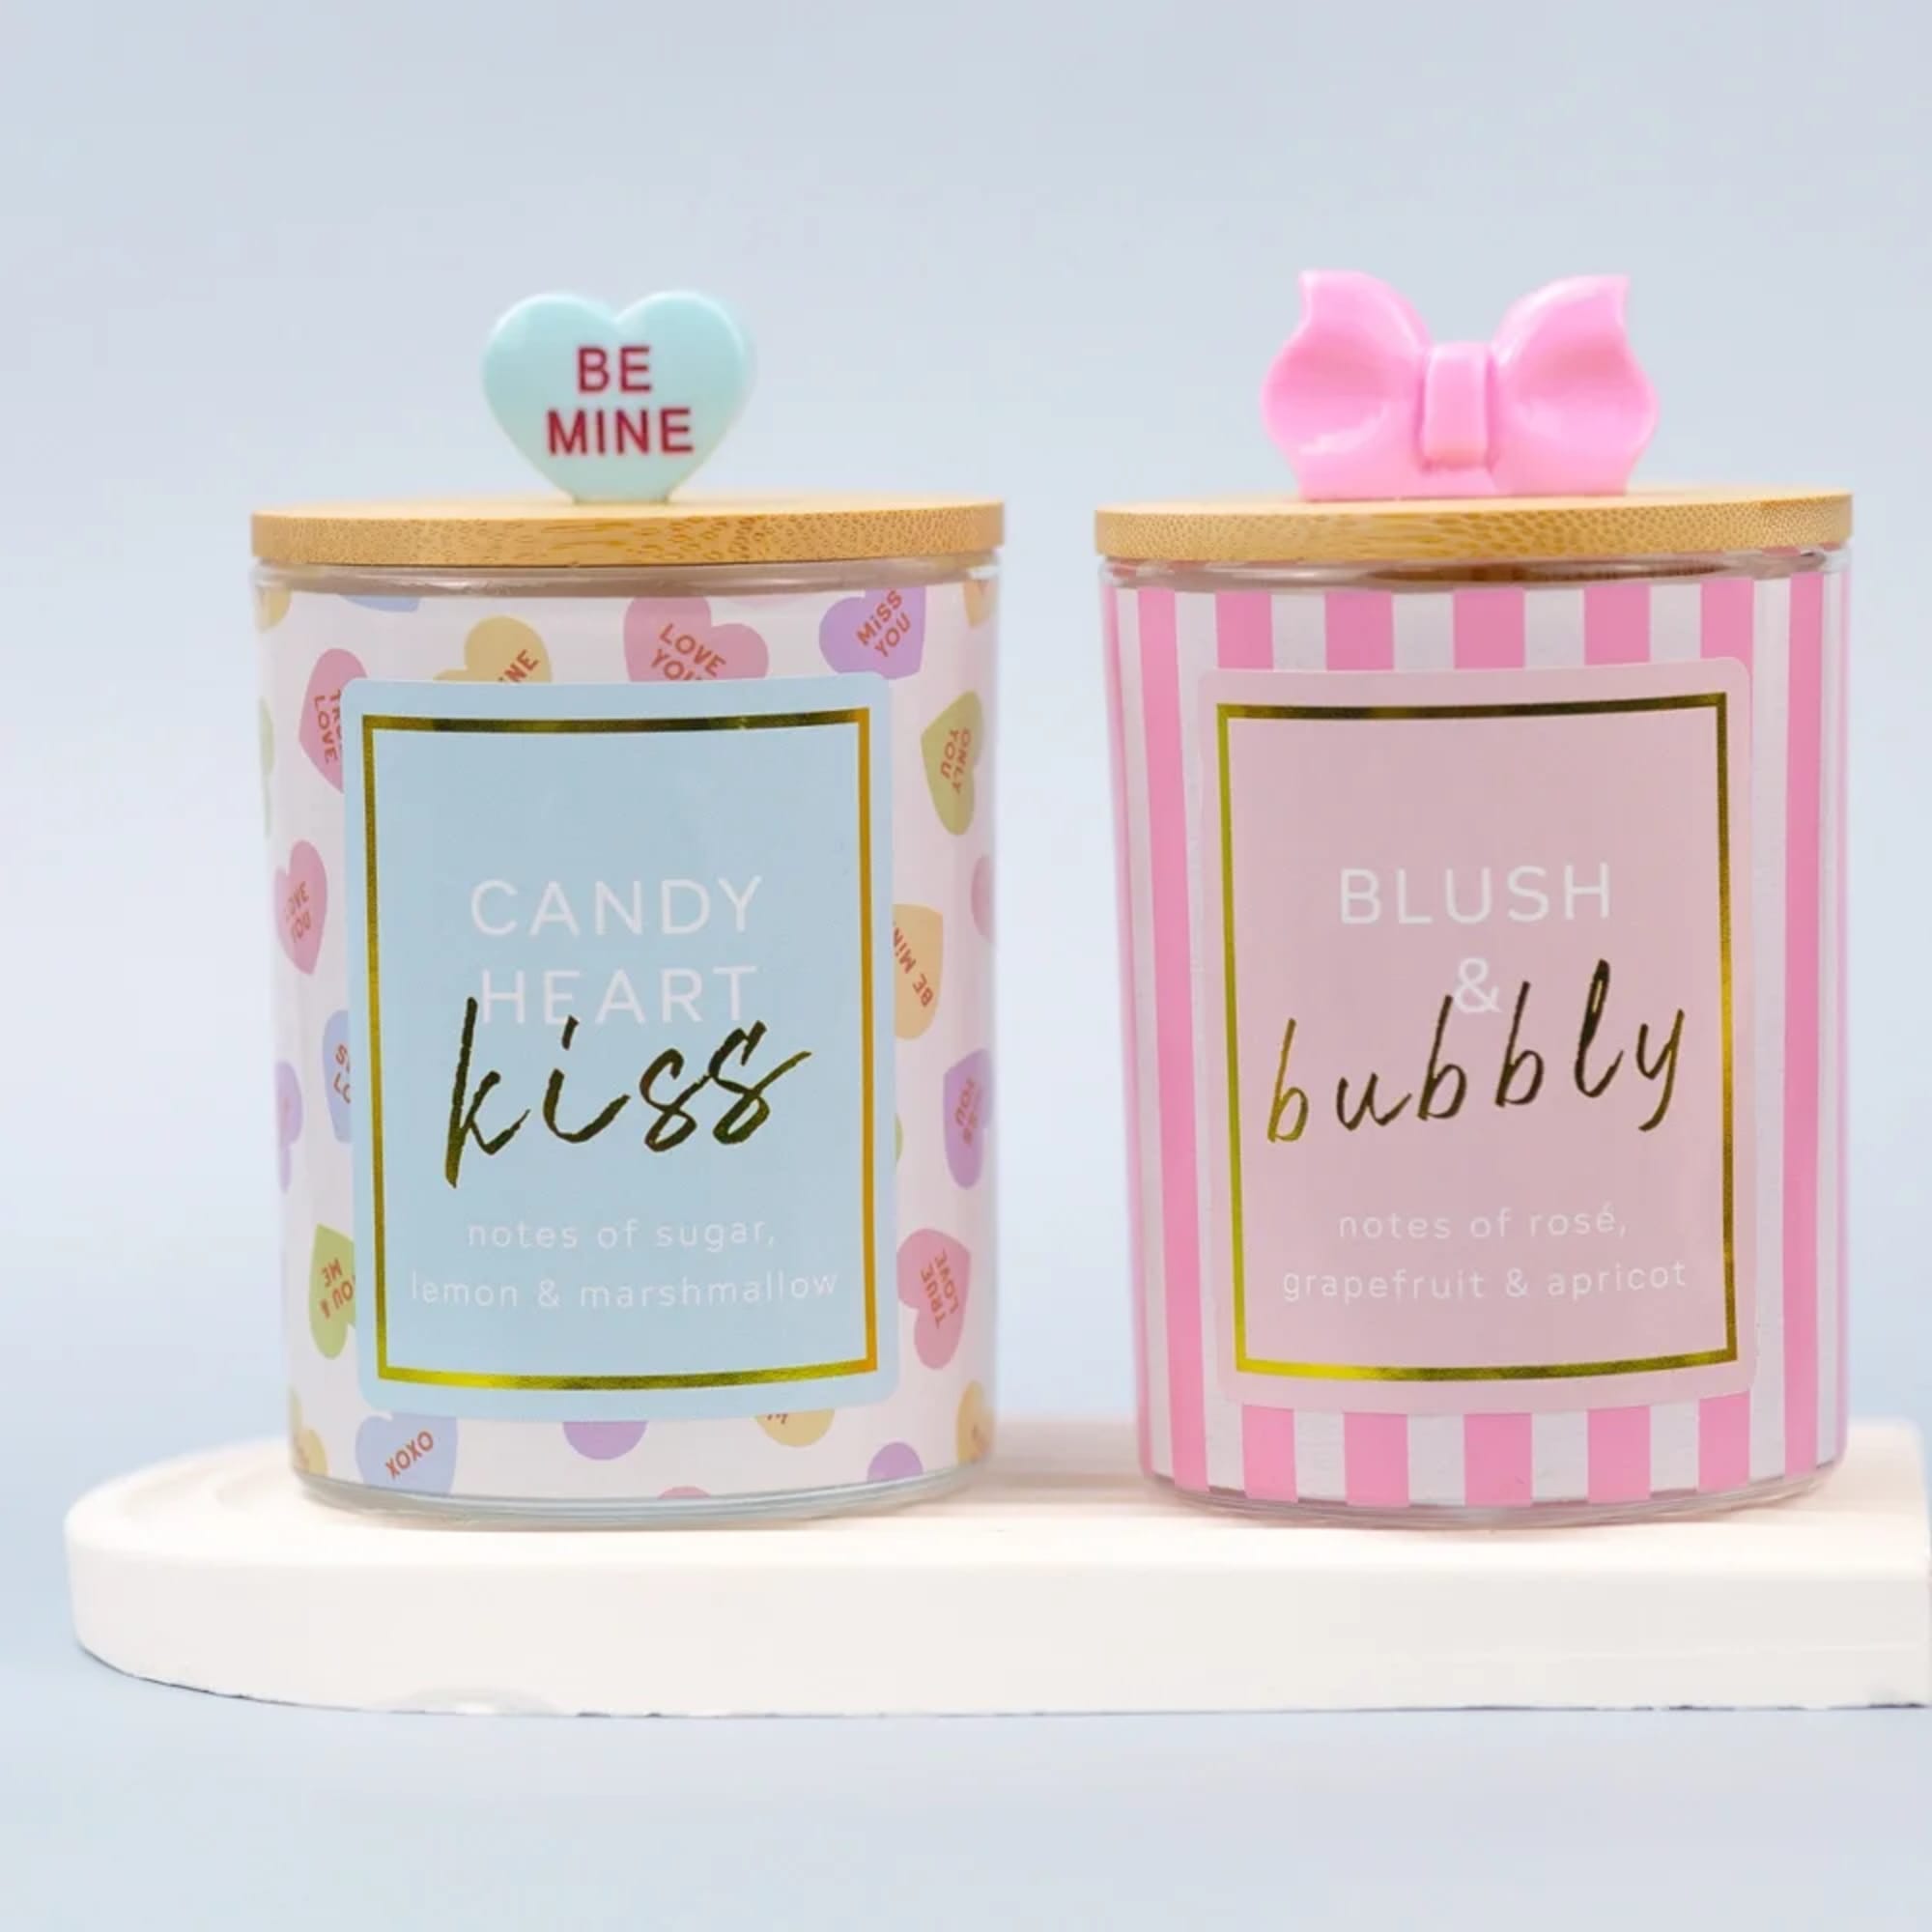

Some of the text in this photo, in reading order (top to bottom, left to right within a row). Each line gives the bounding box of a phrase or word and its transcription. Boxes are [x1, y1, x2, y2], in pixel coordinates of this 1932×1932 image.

[577, 345, 652, 394] BE
[546, 407, 694, 456] MINE
[659, 623, 726, 678] LOVE
[873, 611, 911, 658] YOU
[497, 648, 540, 683] NE
[650, 648, 703, 680] YO
[314, 695, 338, 765] LOVE
[940, 729, 959, 780] YOU
[952, 727, 972, 794] ONLY
[470, 876, 763, 936] CANDY
[1339, 862, 1611, 925] BLUSH
[481, 965, 758, 1026] HEART
[912, 973, 934, 1007] BE
[1453, 957, 1502, 1014] &
[1266, 958, 1686, 1144] bubbly
[444, 996, 813, 1189] kiss
[468, 1216, 776, 1253] notes of sugar,
[1339, 1202, 1628, 1239] notes of rosé,
[331, 1274, 355, 1311] OU
[411, 1267, 839, 1309] lemon & marshmallow
[921, 1261, 947, 1330] TRUE
[934, 1247, 959, 1315] LOVE
[1283, 1259, 1687, 1304] grapefruit & apricot
[385, 1431, 434, 1479] XOXO
